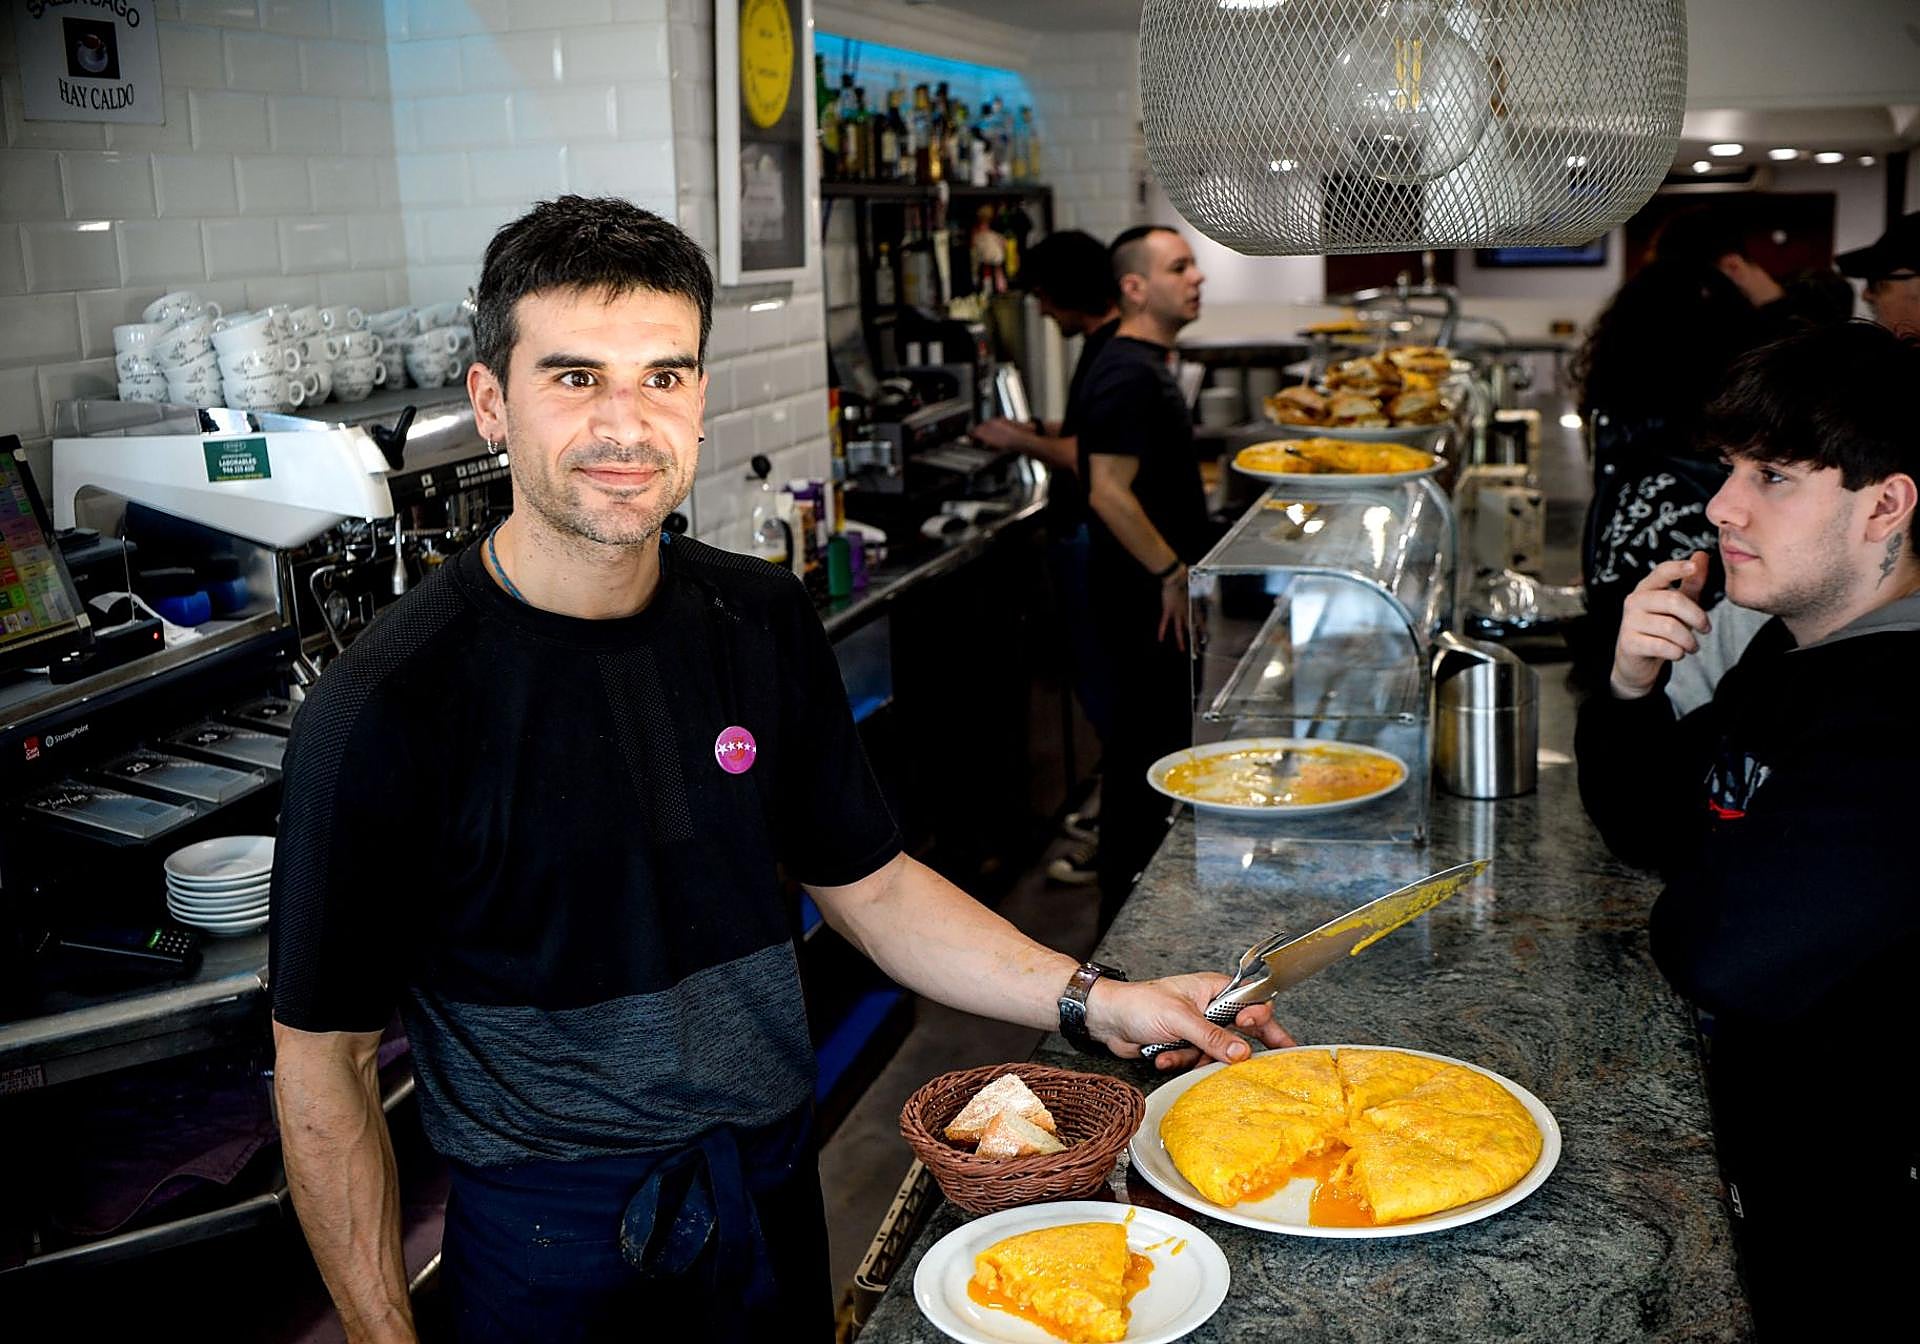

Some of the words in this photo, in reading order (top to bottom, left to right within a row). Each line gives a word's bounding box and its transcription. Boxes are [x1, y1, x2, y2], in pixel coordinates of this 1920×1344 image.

[58, 78, 87, 109] HAY
[90, 84, 135, 110] CALDO
[54, 724, 89, 743] StrongPoint
